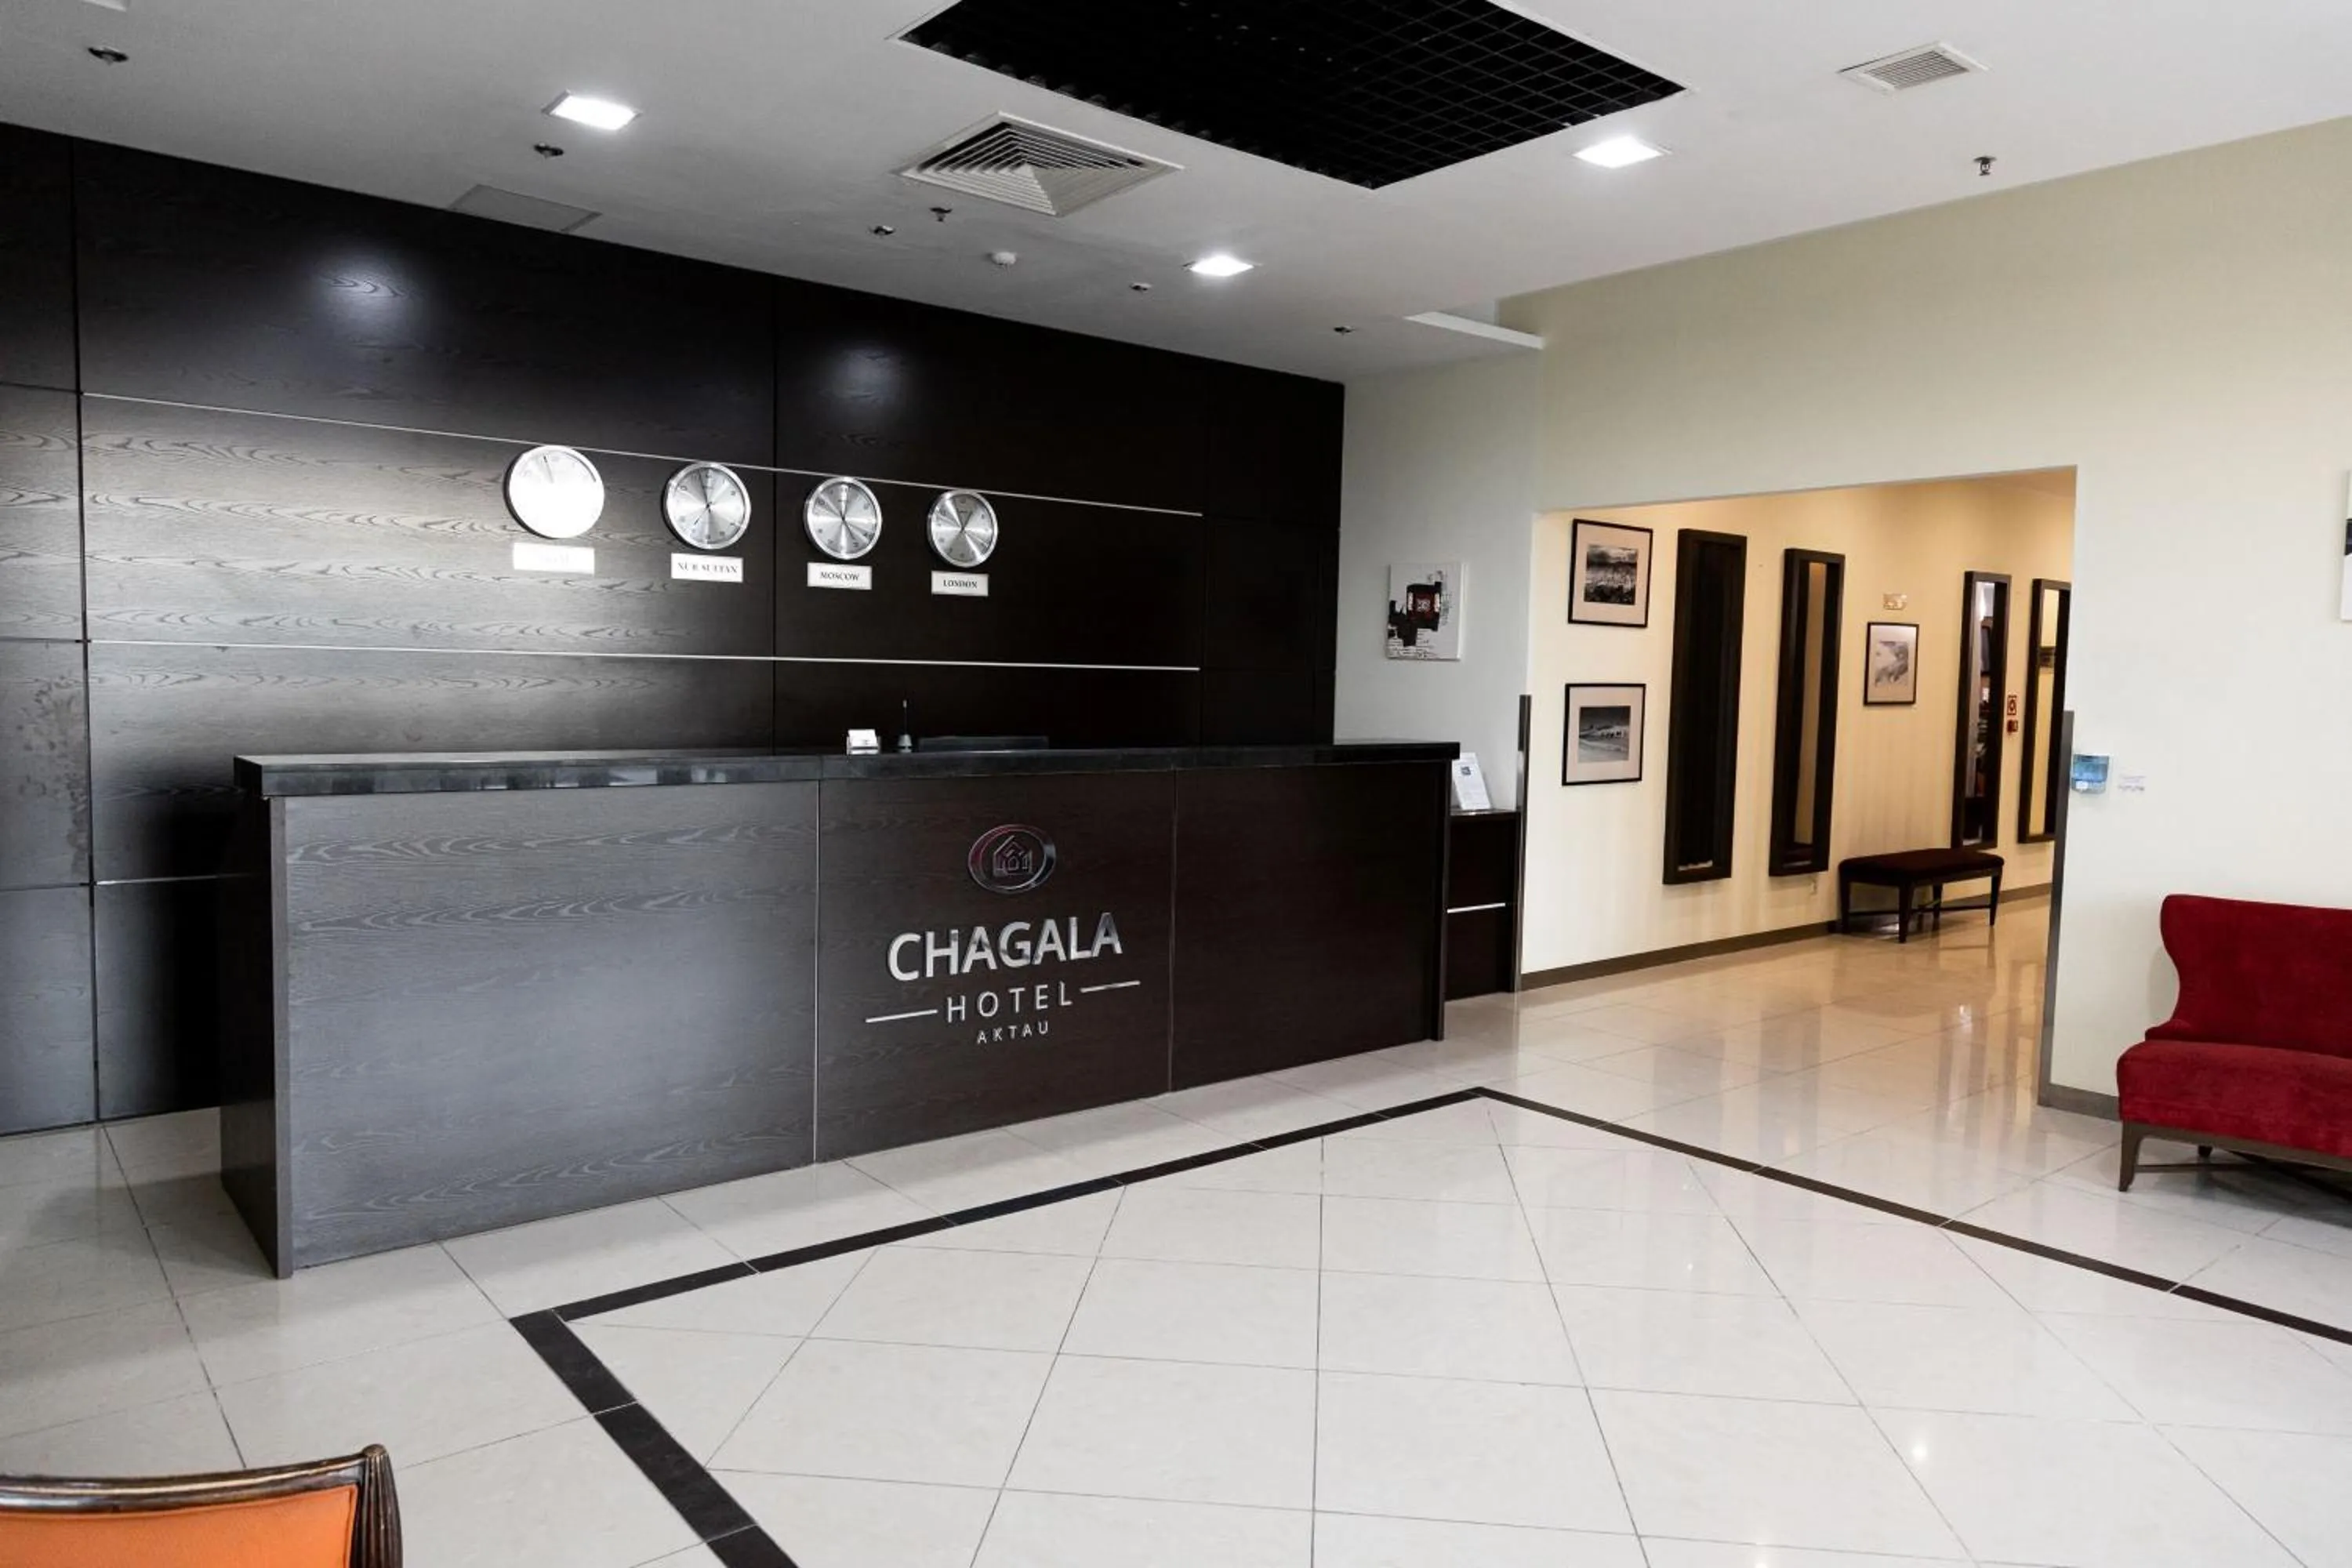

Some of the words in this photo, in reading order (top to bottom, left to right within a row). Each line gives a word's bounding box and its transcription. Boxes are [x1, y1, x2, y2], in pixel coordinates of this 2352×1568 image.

[819, 571, 860, 581] MOSCOW
[942, 579, 978, 589] LONDON
[887, 912, 1123, 981] CHAGALA
[947, 982, 1073, 1023] HOTEL
[976, 1021, 1049, 1045] AKTAU
